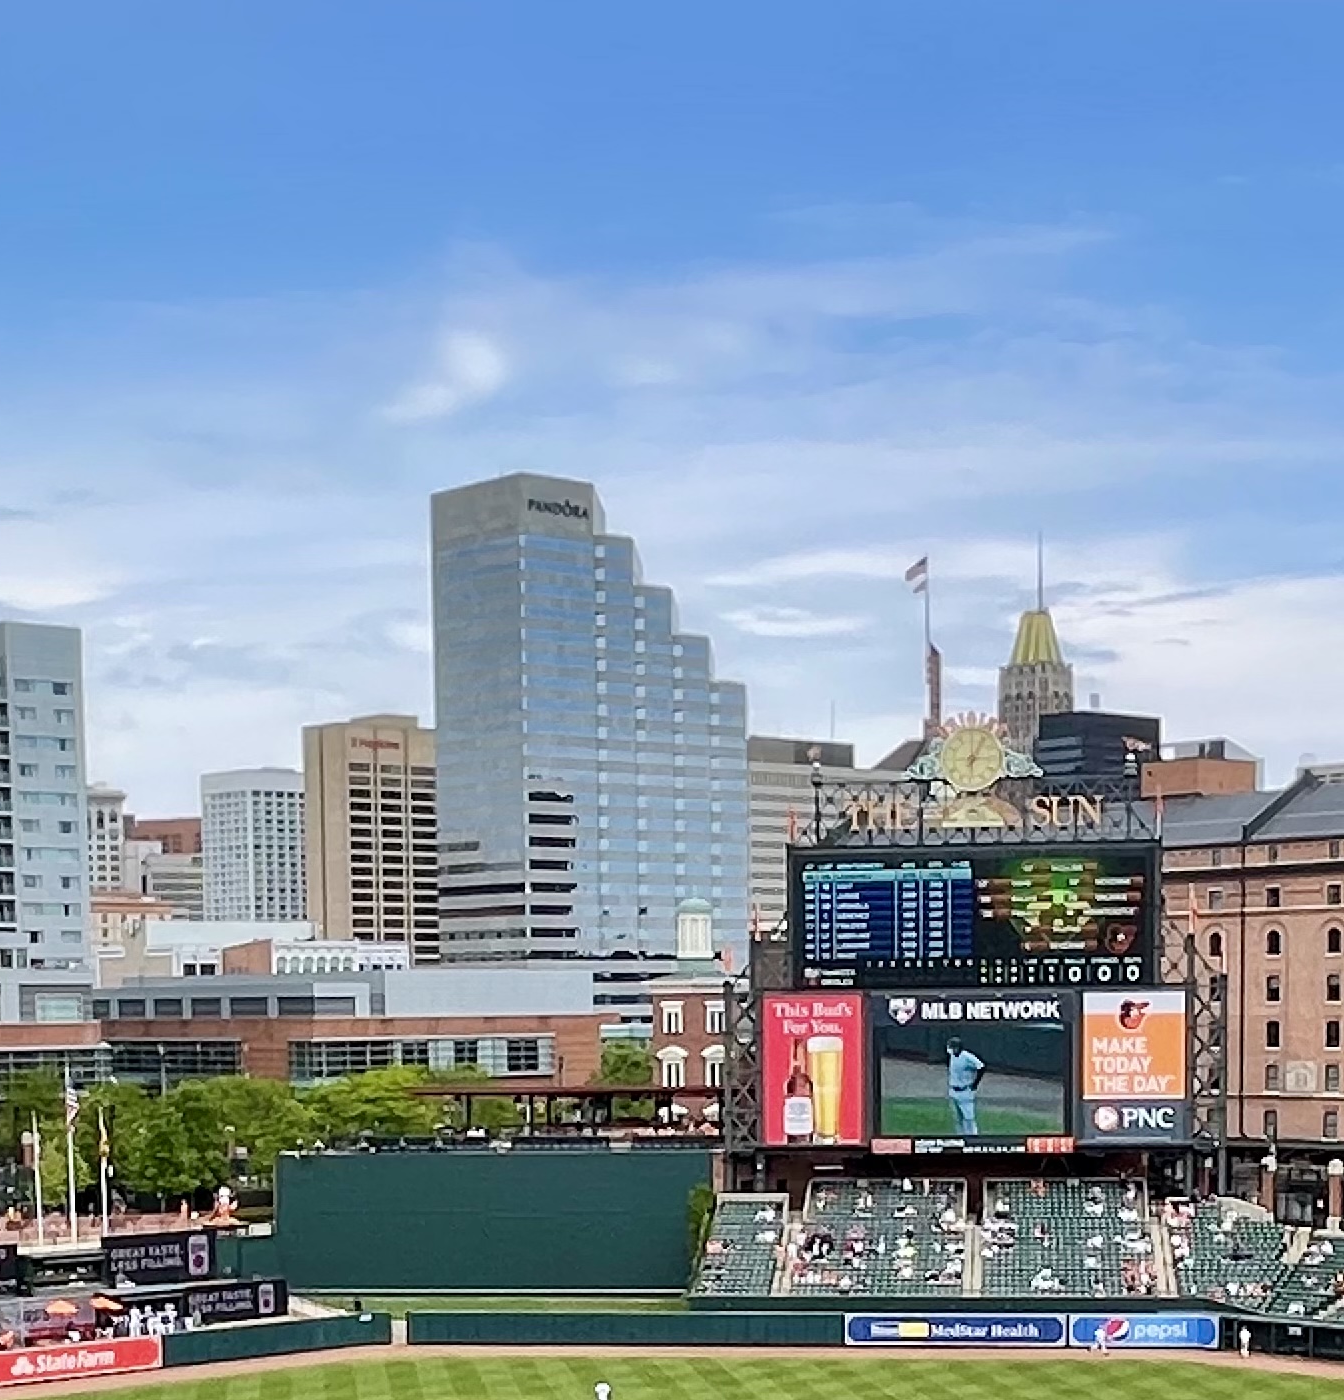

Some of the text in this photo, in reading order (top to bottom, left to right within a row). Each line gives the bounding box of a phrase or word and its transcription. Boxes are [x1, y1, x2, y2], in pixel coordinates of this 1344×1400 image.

[846, 795, 1105, 831] THE SUN
[1068, 966, 1082, 982] 0
[1097, 965, 1112, 981] 0
[1126, 965, 1140, 981] 0
[772, 1002, 853, 1018] This Bud's
[921, 1000, 1060, 1020] MLB NETWORK
[783, 1018, 844, 1034] For You.
[1092, 1036, 1148, 1054] MAKE
[1091, 1056, 1153, 1074] TODAY
[1091, 1074, 1172, 1094] THE DAY
[1120, 1106, 1176, 1129] PNC
[930, 1322, 988, 1339] MedStar
[990, 1322, 1040, 1339] Health
[1133, 1318, 1188, 1344] pepsi
